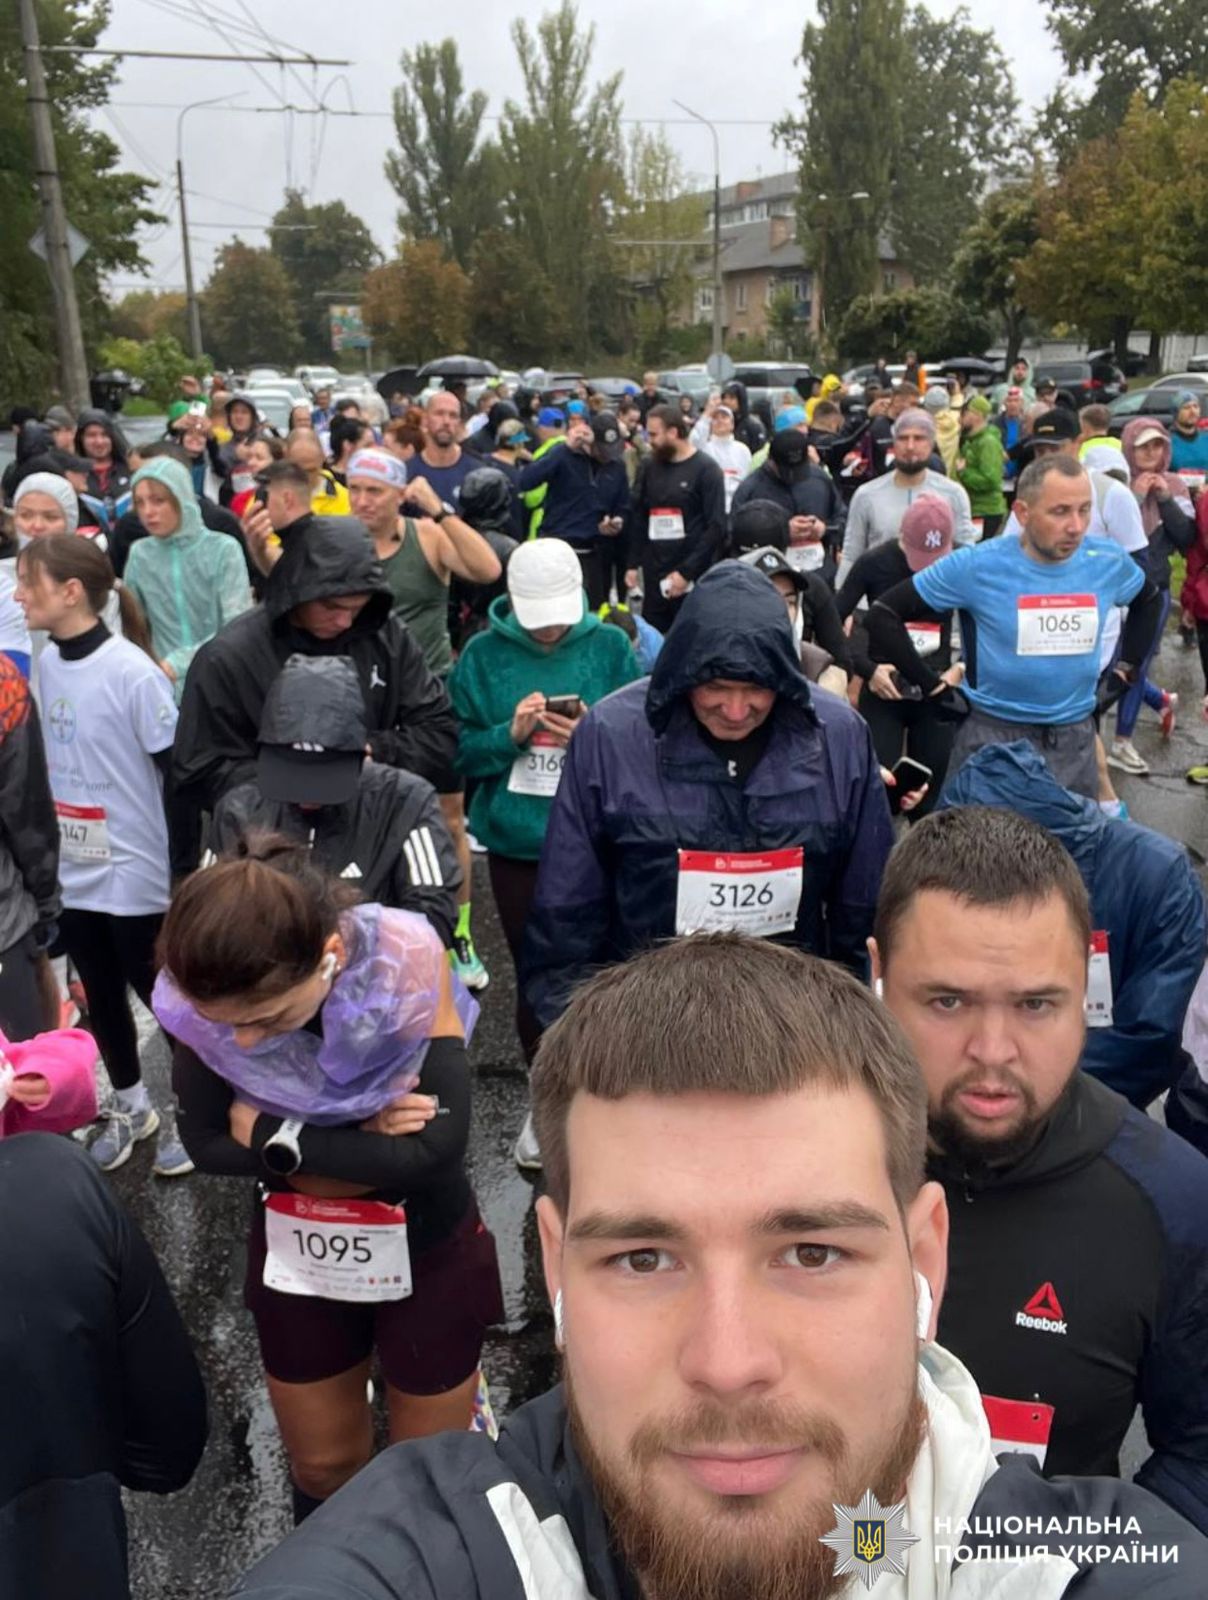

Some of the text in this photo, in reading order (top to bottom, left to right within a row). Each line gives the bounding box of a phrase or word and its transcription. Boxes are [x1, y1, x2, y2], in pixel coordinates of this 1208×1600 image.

[1038, 614, 1081, 632] 1065
[709, 882, 774, 907] 3126
[293, 1229, 372, 1263] 1095
[1016, 1311, 1068, 1335] Reebok
